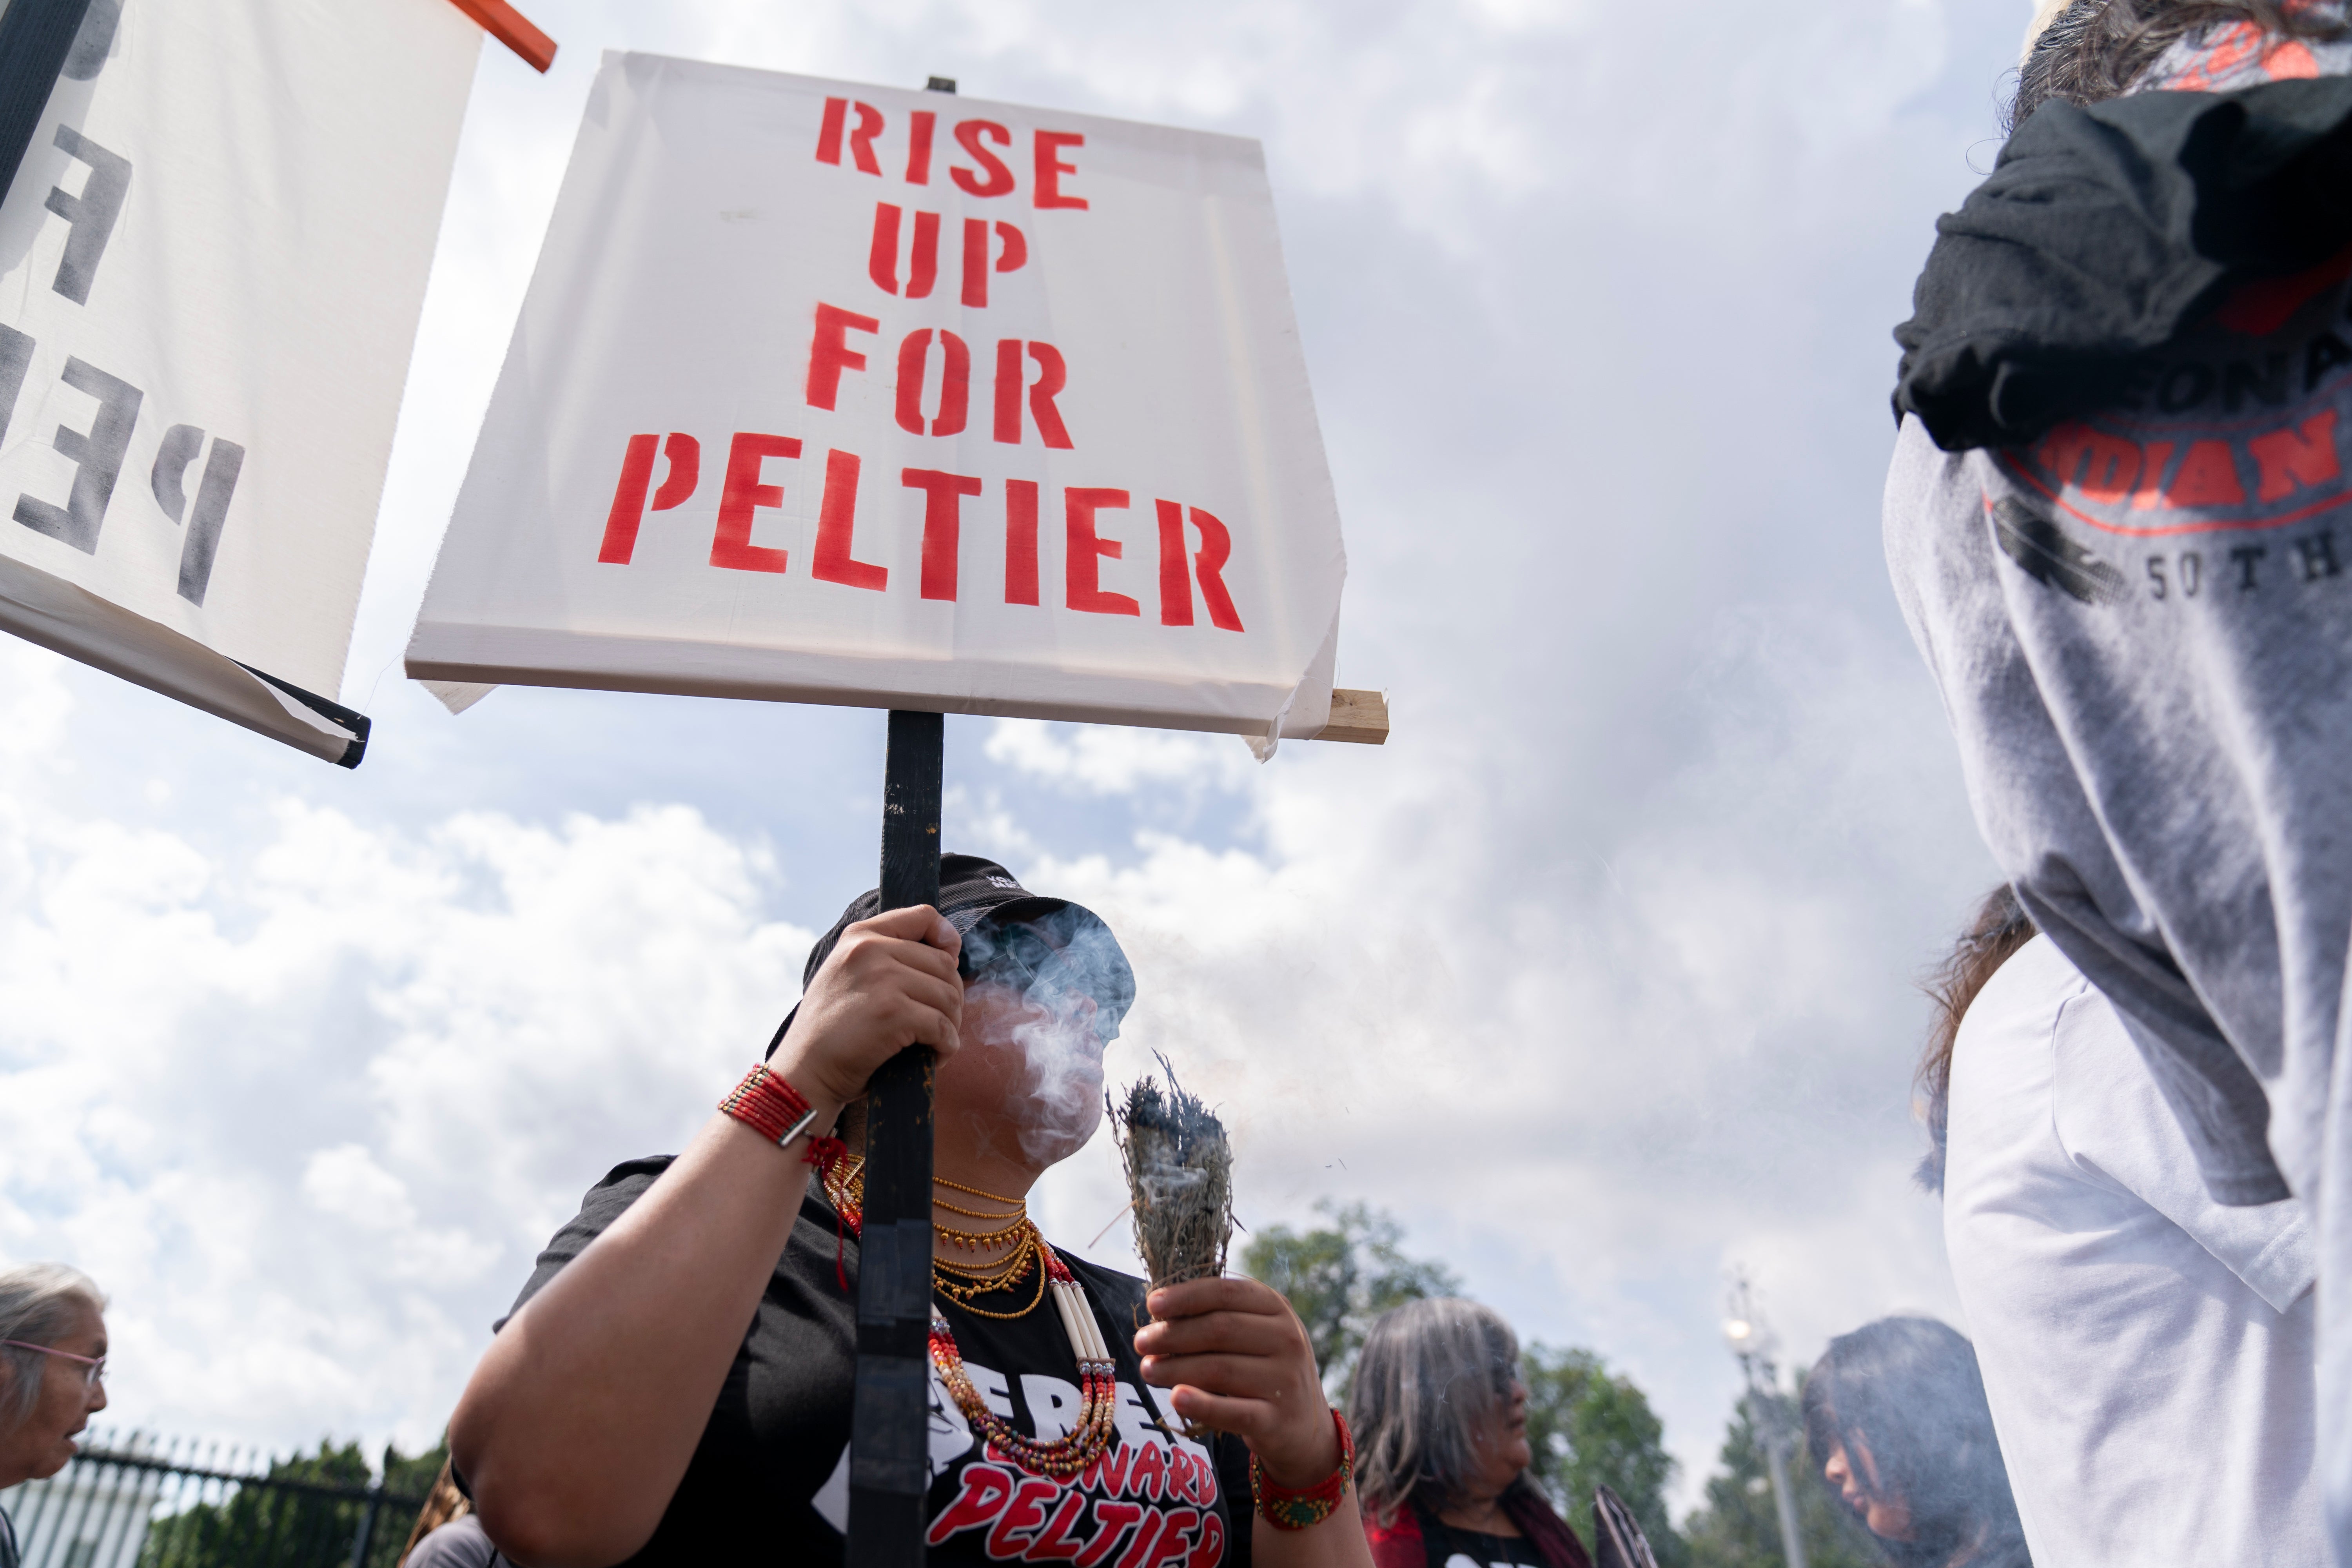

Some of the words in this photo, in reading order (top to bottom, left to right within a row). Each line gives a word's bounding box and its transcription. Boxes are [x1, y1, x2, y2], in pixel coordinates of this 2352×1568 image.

[816, 97, 1088, 210] RISE
[869, 202, 1027, 308] UP
[806, 302, 1073, 449] FOR
[598, 434, 1243, 632] PELTIER
[982, 1439, 1217, 1509] NARD
